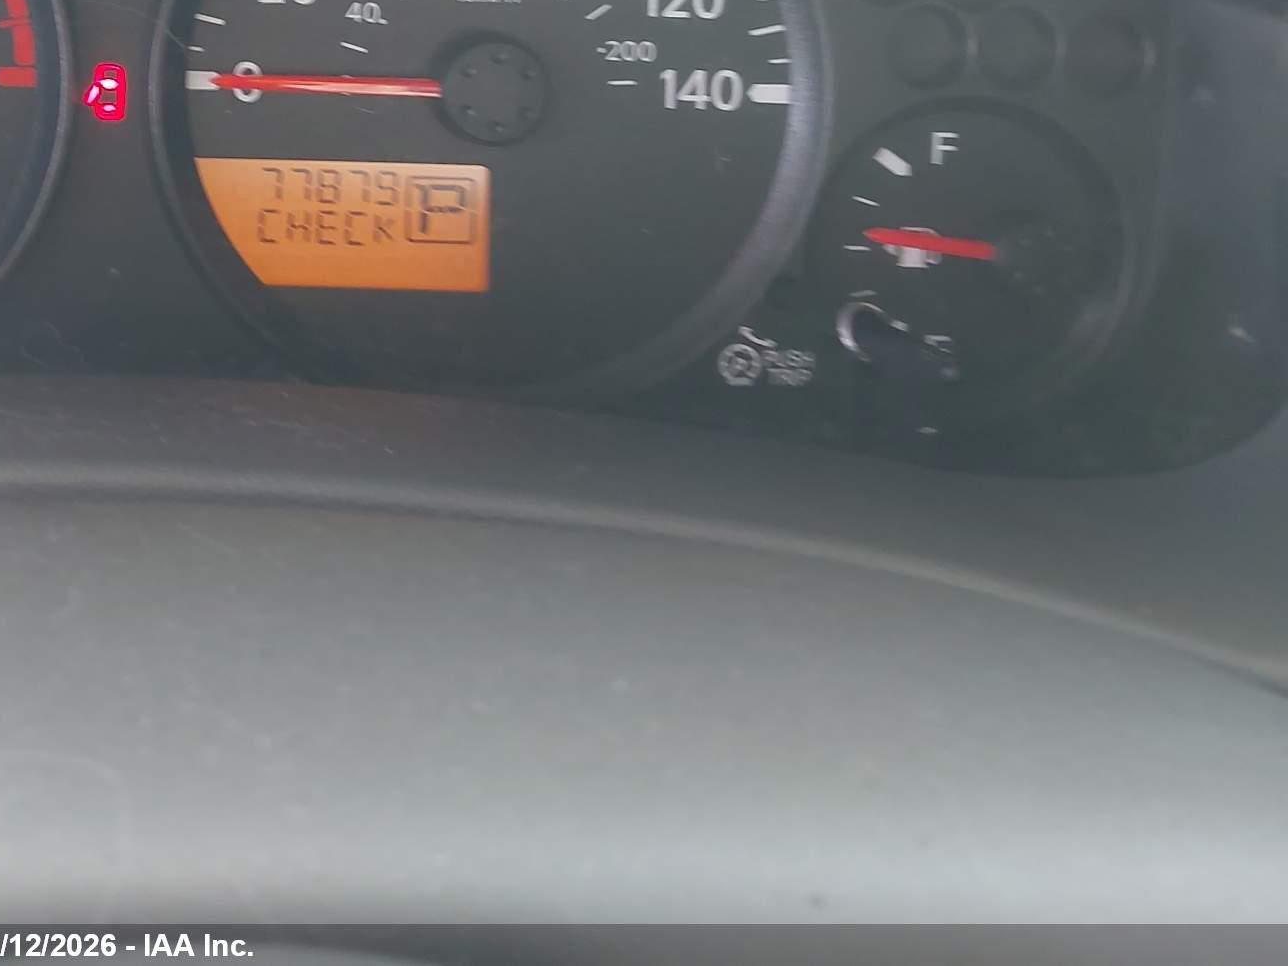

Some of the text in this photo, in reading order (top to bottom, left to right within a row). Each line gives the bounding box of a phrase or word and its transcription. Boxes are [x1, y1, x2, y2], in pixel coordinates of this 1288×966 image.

[345, 0, 380, 23] 40
[604, 39, 656, 63] 200
[659, 68, 744, 111] 140
[929, 131, 960, 165] F
[261, 166, 400, 206] 77879
[257, 208, 398, 247] CHECK
[415, 183, 469, 235] P
